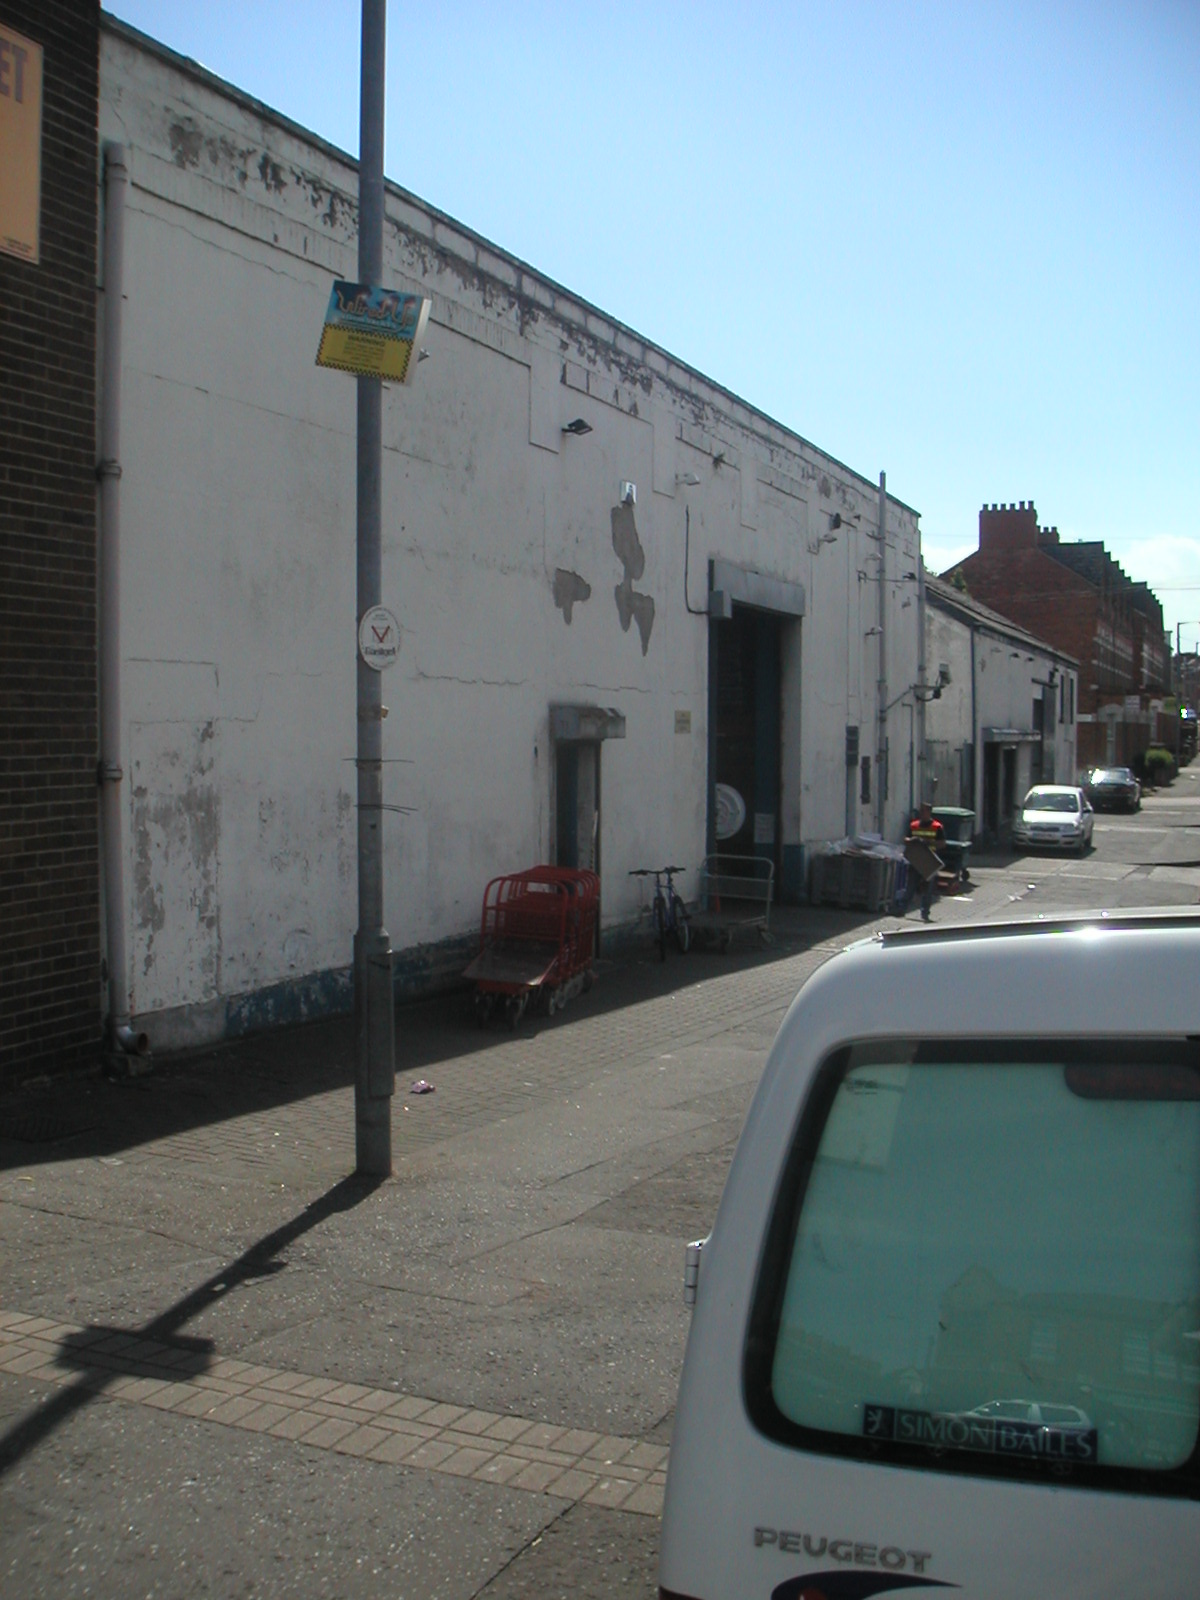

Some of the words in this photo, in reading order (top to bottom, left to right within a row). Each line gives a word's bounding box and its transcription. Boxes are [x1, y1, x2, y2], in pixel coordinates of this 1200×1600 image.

[901, 1412, 991, 1446] SIMON
[1000, 1425, 1093, 1458] BAILES
[754, 1527, 932, 1573] PEUGEOT
